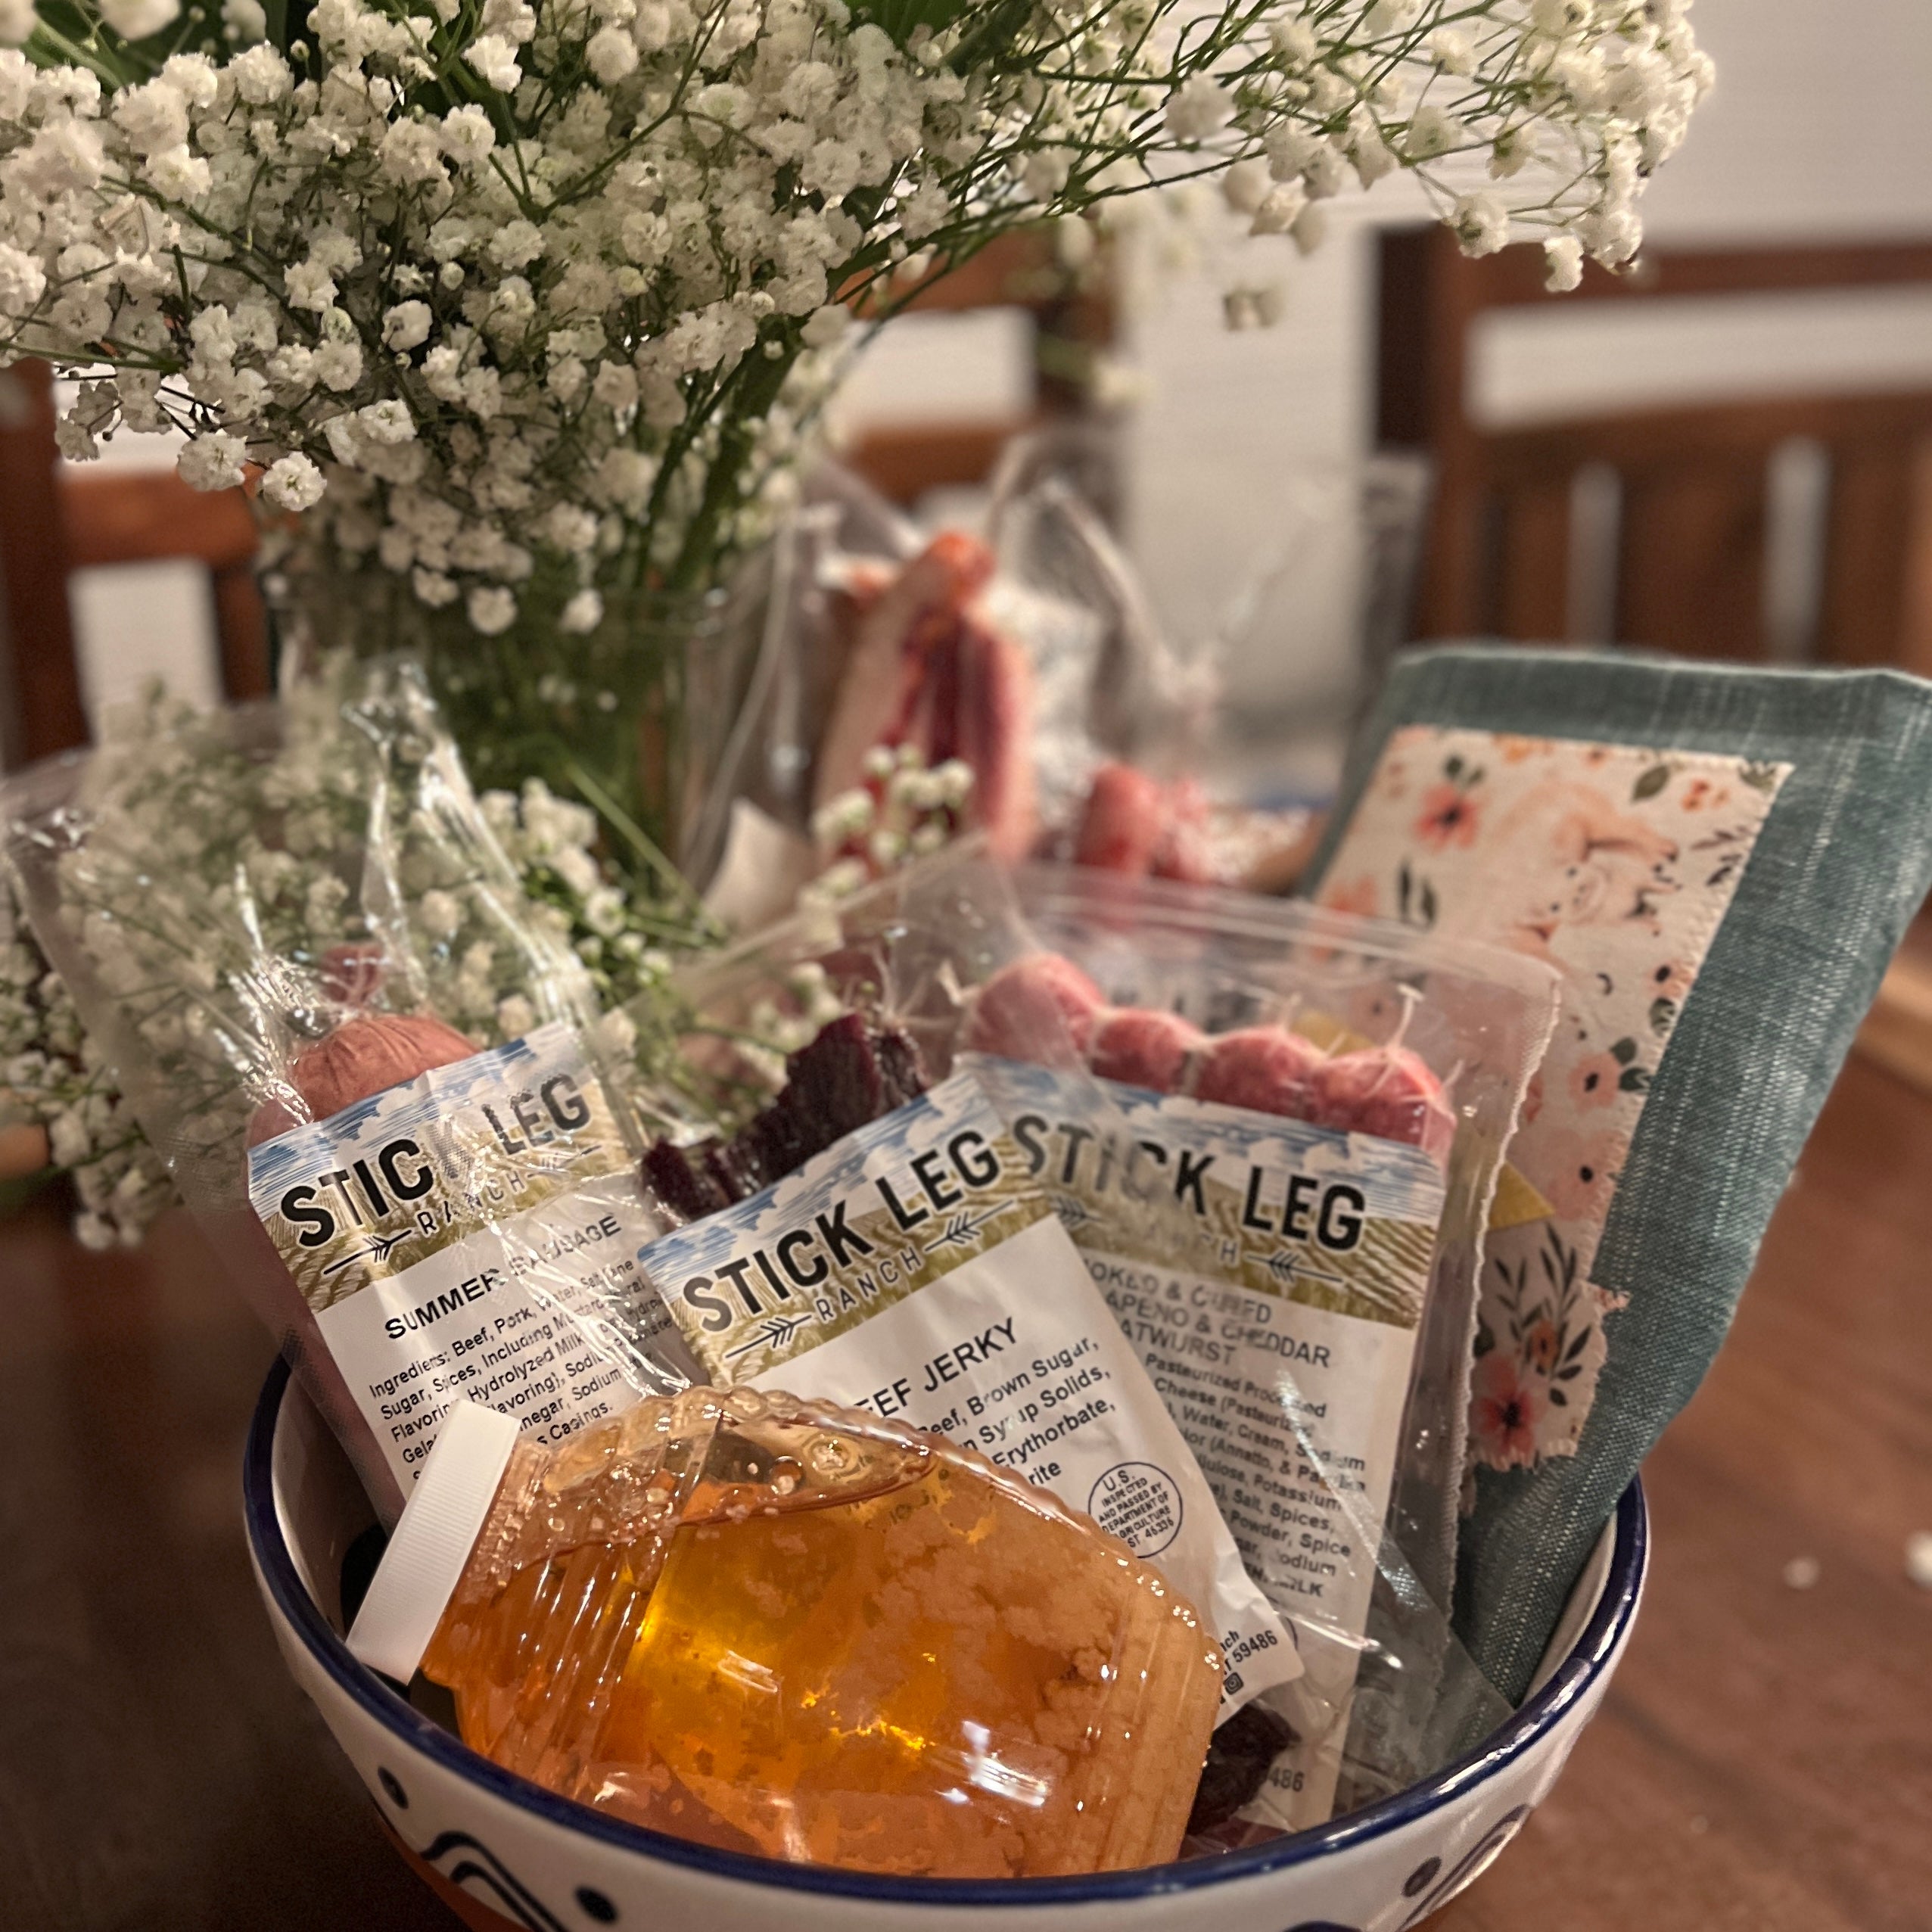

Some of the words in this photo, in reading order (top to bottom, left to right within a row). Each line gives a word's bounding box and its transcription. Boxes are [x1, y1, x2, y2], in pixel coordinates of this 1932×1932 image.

[281, 1138, 446, 1247] STIC
[481, 1073, 592, 1156] LEG
[1013, 1115, 1215, 1216] STICK
[1243, 1165, 1365, 1251] LEG
[509, 1212, 621, 1277] SUSAGE
[683, 1200, 875, 1333] STICK
[876, 1131, 999, 1232] LEG
[385, 1268, 506, 1339] SUMMER
[817, 1247, 922, 1322] RANCH
[1087, 1258, 1159, 1296] OKED
[452, 1327, 494, 1357] Beef,
[494, 1305, 537, 1334] Pork,
[1106, 1288, 1190, 1329] APENO
[1195, 1314, 1211, 1334] &
[1221, 1319, 1331, 1368] CHEDDAR
[1120, 1318, 1237, 1365] ATWURST
[381, 1388, 432, 1420] Sugar,
[482, 1324, 553, 1368] Including
[391, 1400, 458, 1442] Flavorin
[468, 1346, 555, 1403] Hydrolyzed
[490, 1371, 565, 1414] lavoring),
[565, 1352, 605, 1378] Sodiu
[571, 1367, 622, 1402] Sodium
[852, 1377, 912, 1417] EEF
[923, 1317, 1016, 1392] JERKY
[918, 1408, 969, 1438] eef,
[966, 1373, 1031, 1417] Brown
[1031, 1337, 1100, 1378] Sugar,
[1041, 1365, 1111, 1408] Solids,
[1146, 1352, 1240, 1392] Pasteurized
[1244, 1380, 1327, 1418] Procsed
[549, 1401, 613, 1442] Casings.
[992, 1398, 1116, 1468] Erythorbate,
[1154, 1377, 1217, 1406] Cheese
[1221, 1395, 1316, 1438] (Pasteuriz
[1183, 1405, 1234, 1436] Water,
[1238, 1423, 1290, 1455] Cream,
[1296, 1441, 1366, 1472] Sdum
[1211, 1436, 1273, 1473] (Annatto,
[1279, 1460, 1291, 1476] &
[1297, 1464, 1366, 1491] Paika
[1028, 1461, 1062, 1486] rite
[1103, 1470, 1135, 1492] U.S.
[1157, 1490, 1168, 1504] OF
[1196, 1454, 1248, 1483] llulose,
[1253, 1474, 1342, 1511] Potassium
[1099, 1508, 1117, 1523] AND
[1116, 1489, 1150, 1512] PASSED
[1150, 1481, 1162, 1495] BY
[1115, 1505, 1171, 1538] GRICULTURE
[1233, 1489, 1263, 1514] Salt,
[1270, 1501, 1335, 1535] Spices,
[1127, 1533, 1141, 1548] ST
[1230, 1509, 1293, 1548] Powder,
[1299, 1532, 1352, 1557] Spice
[1272, 1548, 1337, 1577] odium
[1232, 1629, 1279, 1663] 59486
[1268, 1766, 1305, 1792] 486
